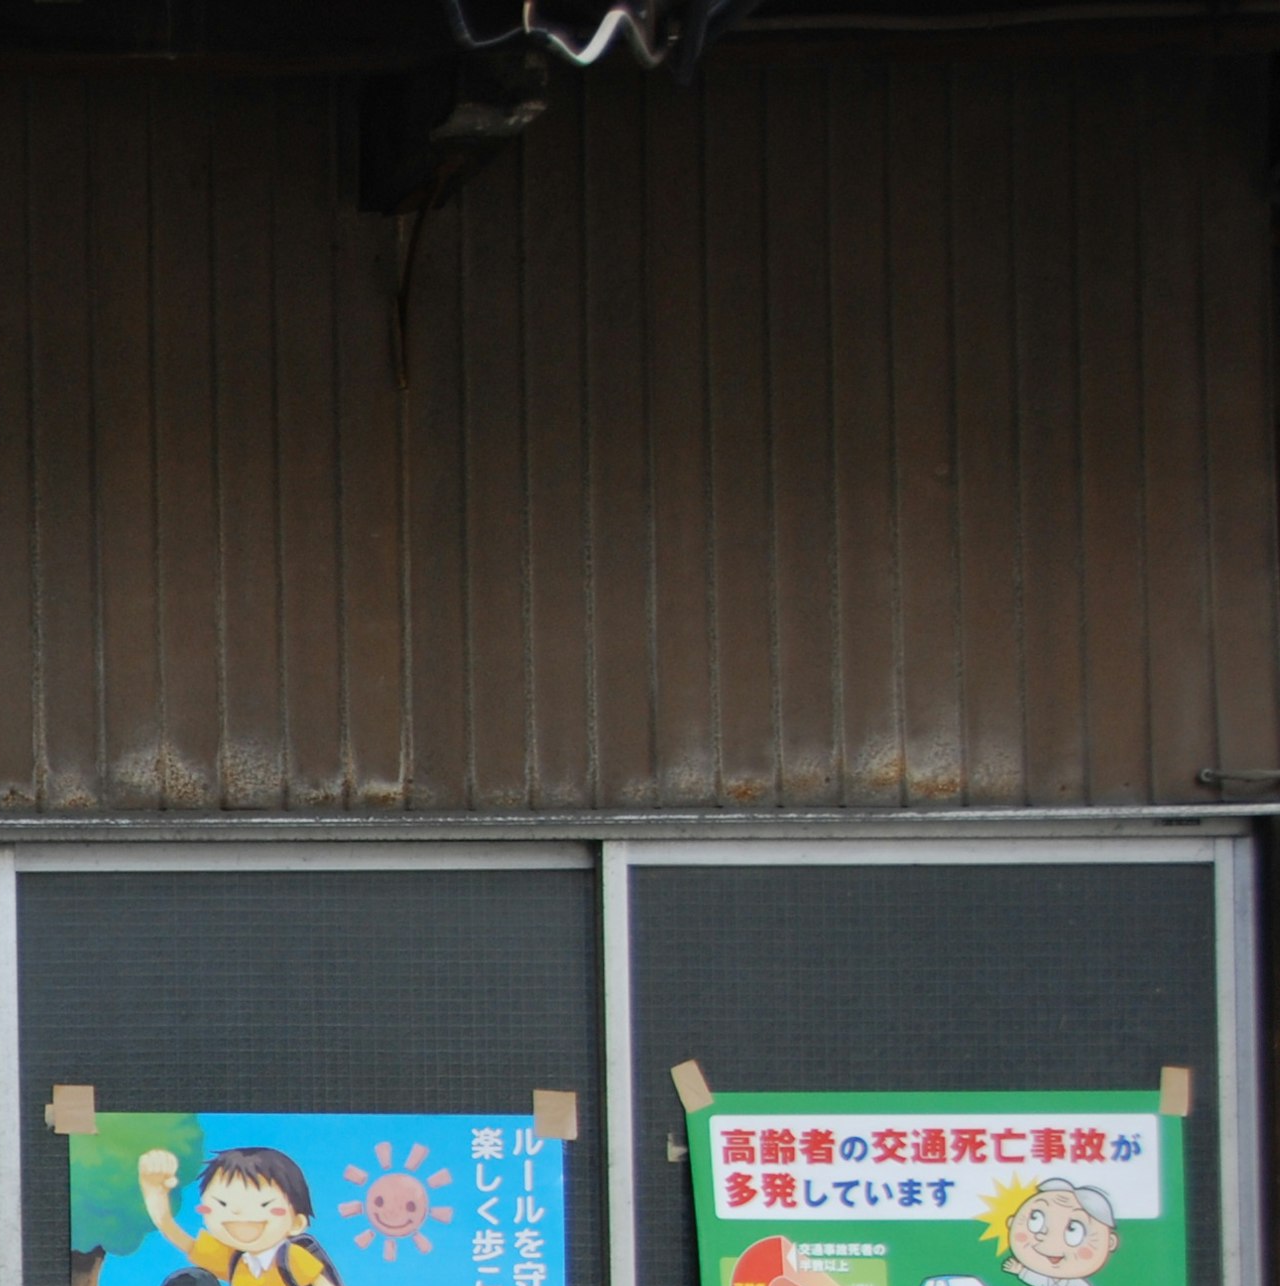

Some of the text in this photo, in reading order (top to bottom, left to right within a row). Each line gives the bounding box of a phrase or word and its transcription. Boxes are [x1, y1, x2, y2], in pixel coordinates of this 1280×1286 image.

[720, 1127, 1142, 1165] 高齢者の交通死亡事故が
[726, 1172, 957, 1208] 多発しています
